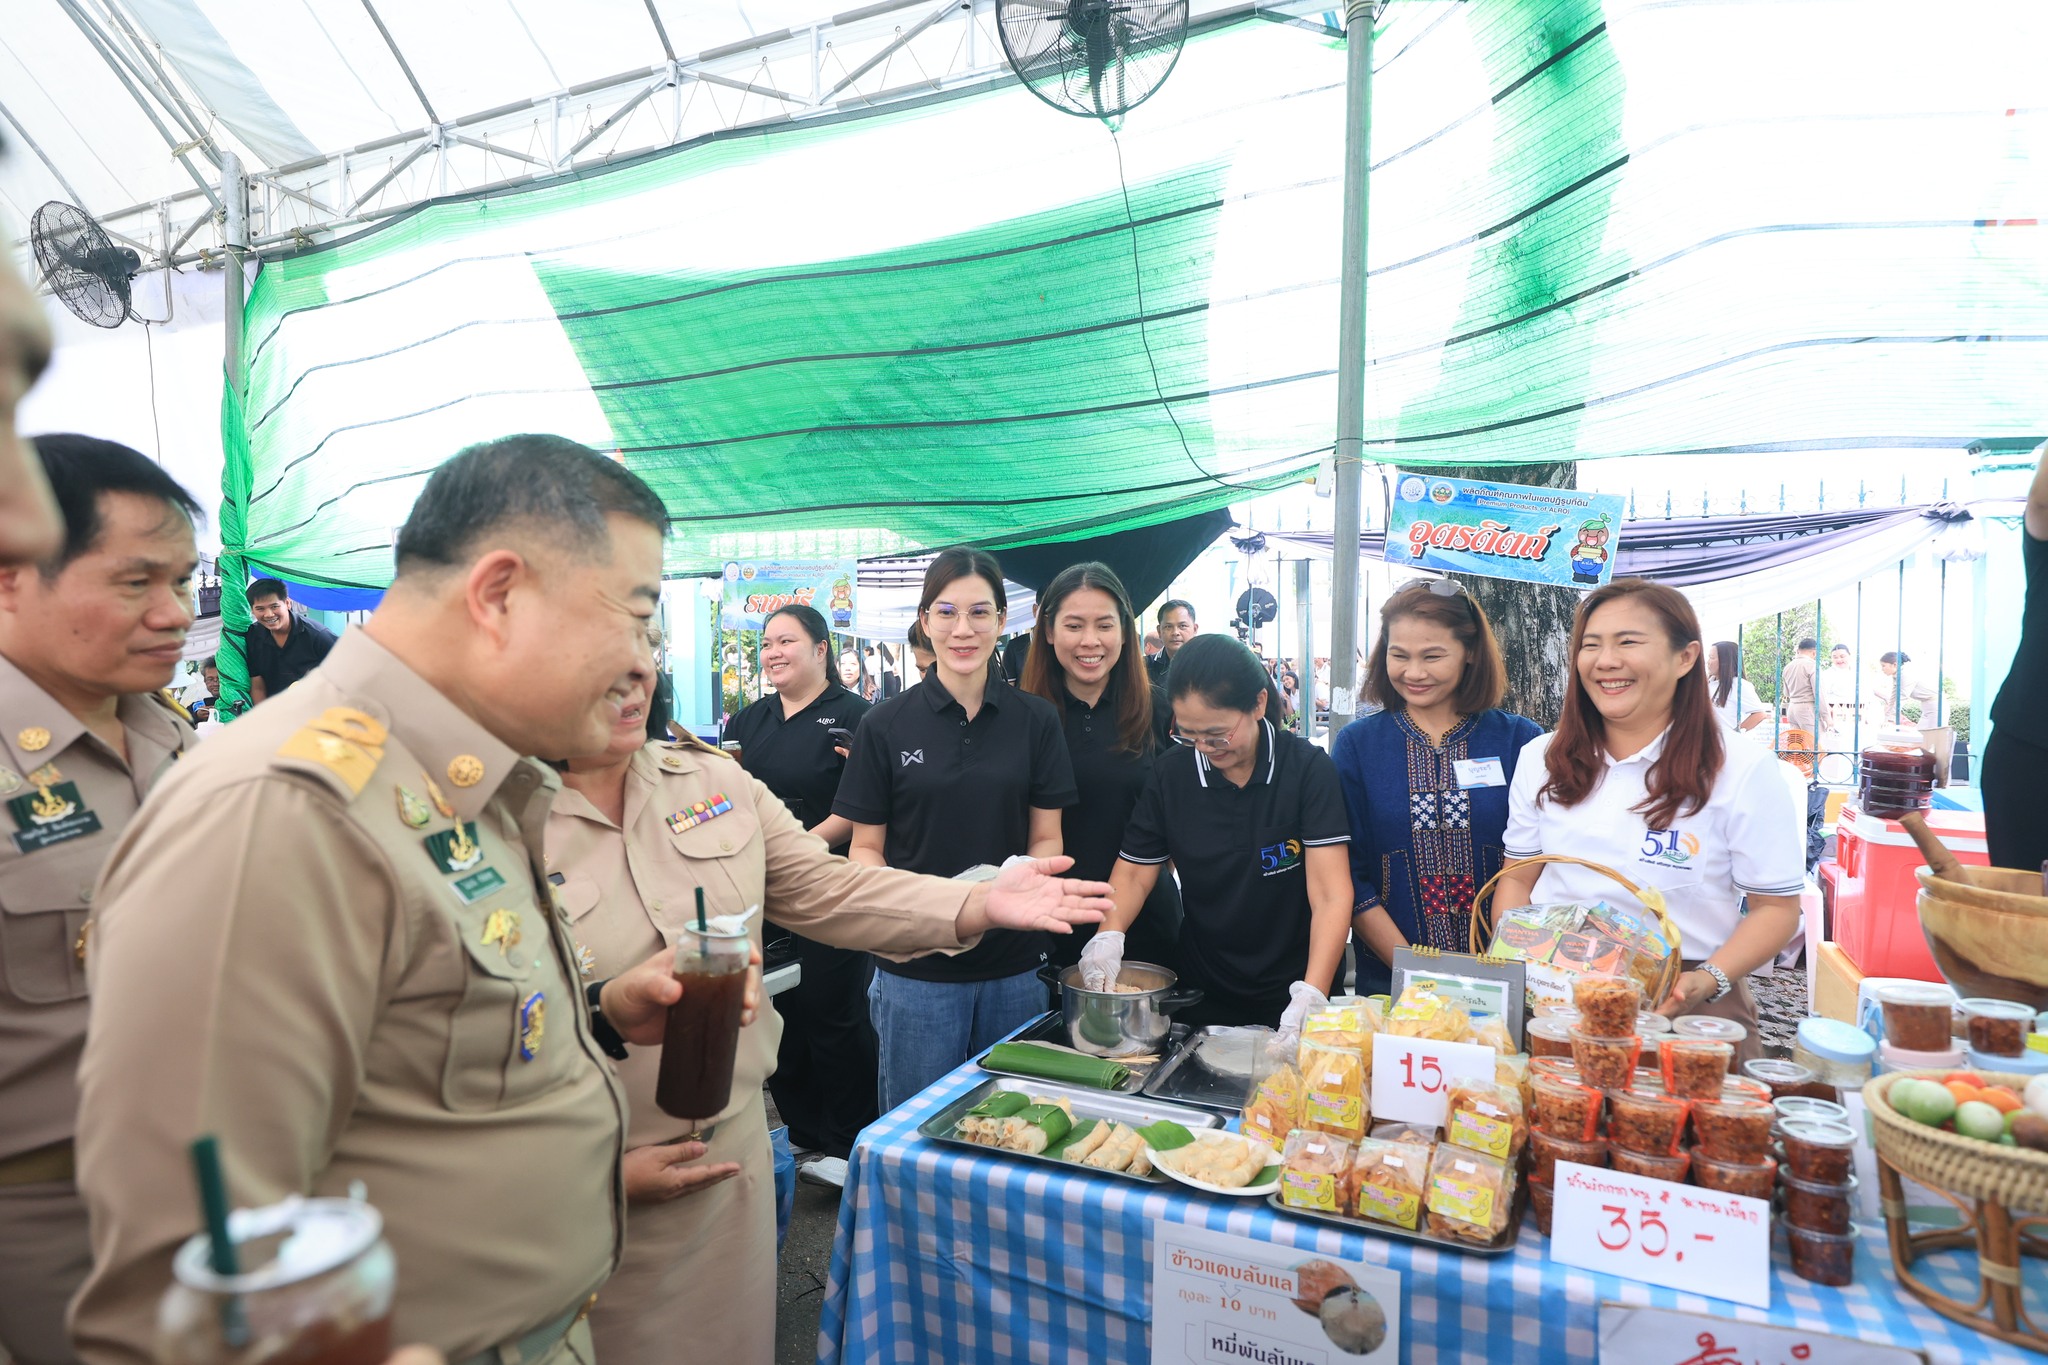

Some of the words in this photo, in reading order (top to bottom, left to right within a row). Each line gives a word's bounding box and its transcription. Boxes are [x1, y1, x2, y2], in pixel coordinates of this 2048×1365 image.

[1509, 502, 1538, 511] Products
[1408, 519, 1558, 559] อุตรดิตถ์
[1261, 842, 1288, 870] 51
[1641, 828, 1680, 857] 51
[1171, 1249, 1293, 1292] ข้าวแคบลับแล
[1220, 1297, 1241, 1311] 10
[1248, 1305, 1276, 1321] บาท
